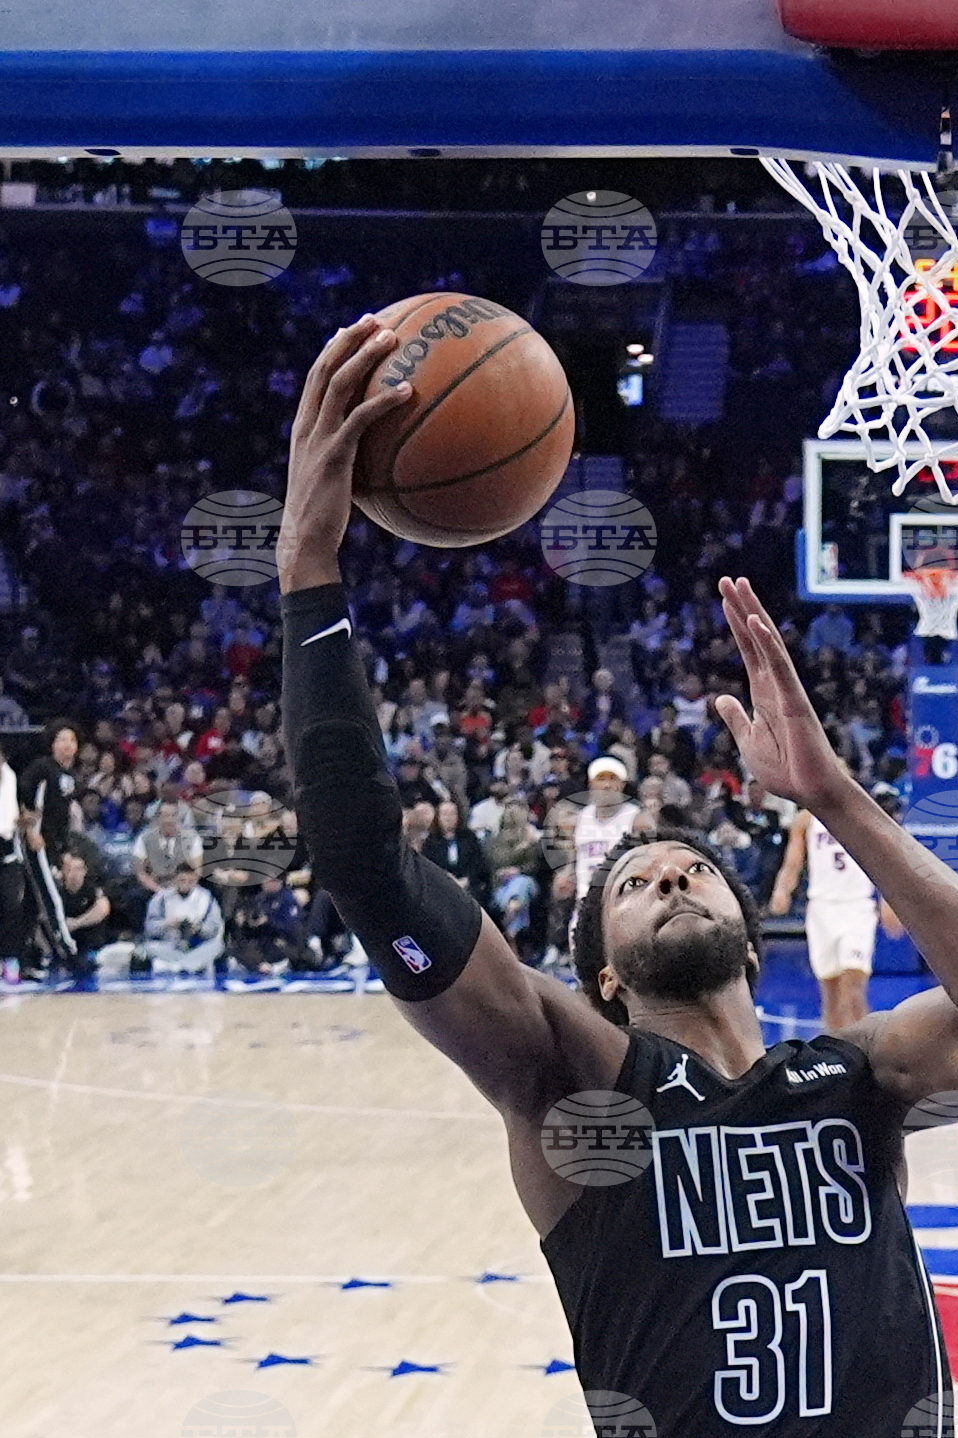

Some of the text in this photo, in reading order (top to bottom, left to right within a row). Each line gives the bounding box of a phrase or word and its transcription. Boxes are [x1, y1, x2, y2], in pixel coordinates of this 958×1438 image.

[379, 298, 515, 387] Wilson
[914, 742, 958, 780] 76
[834, 852, 846, 870] 5
[812, 1061, 847, 1077] Won
[652, 1118, 873, 1260] NETS
[711, 1269, 833, 1426] 31
